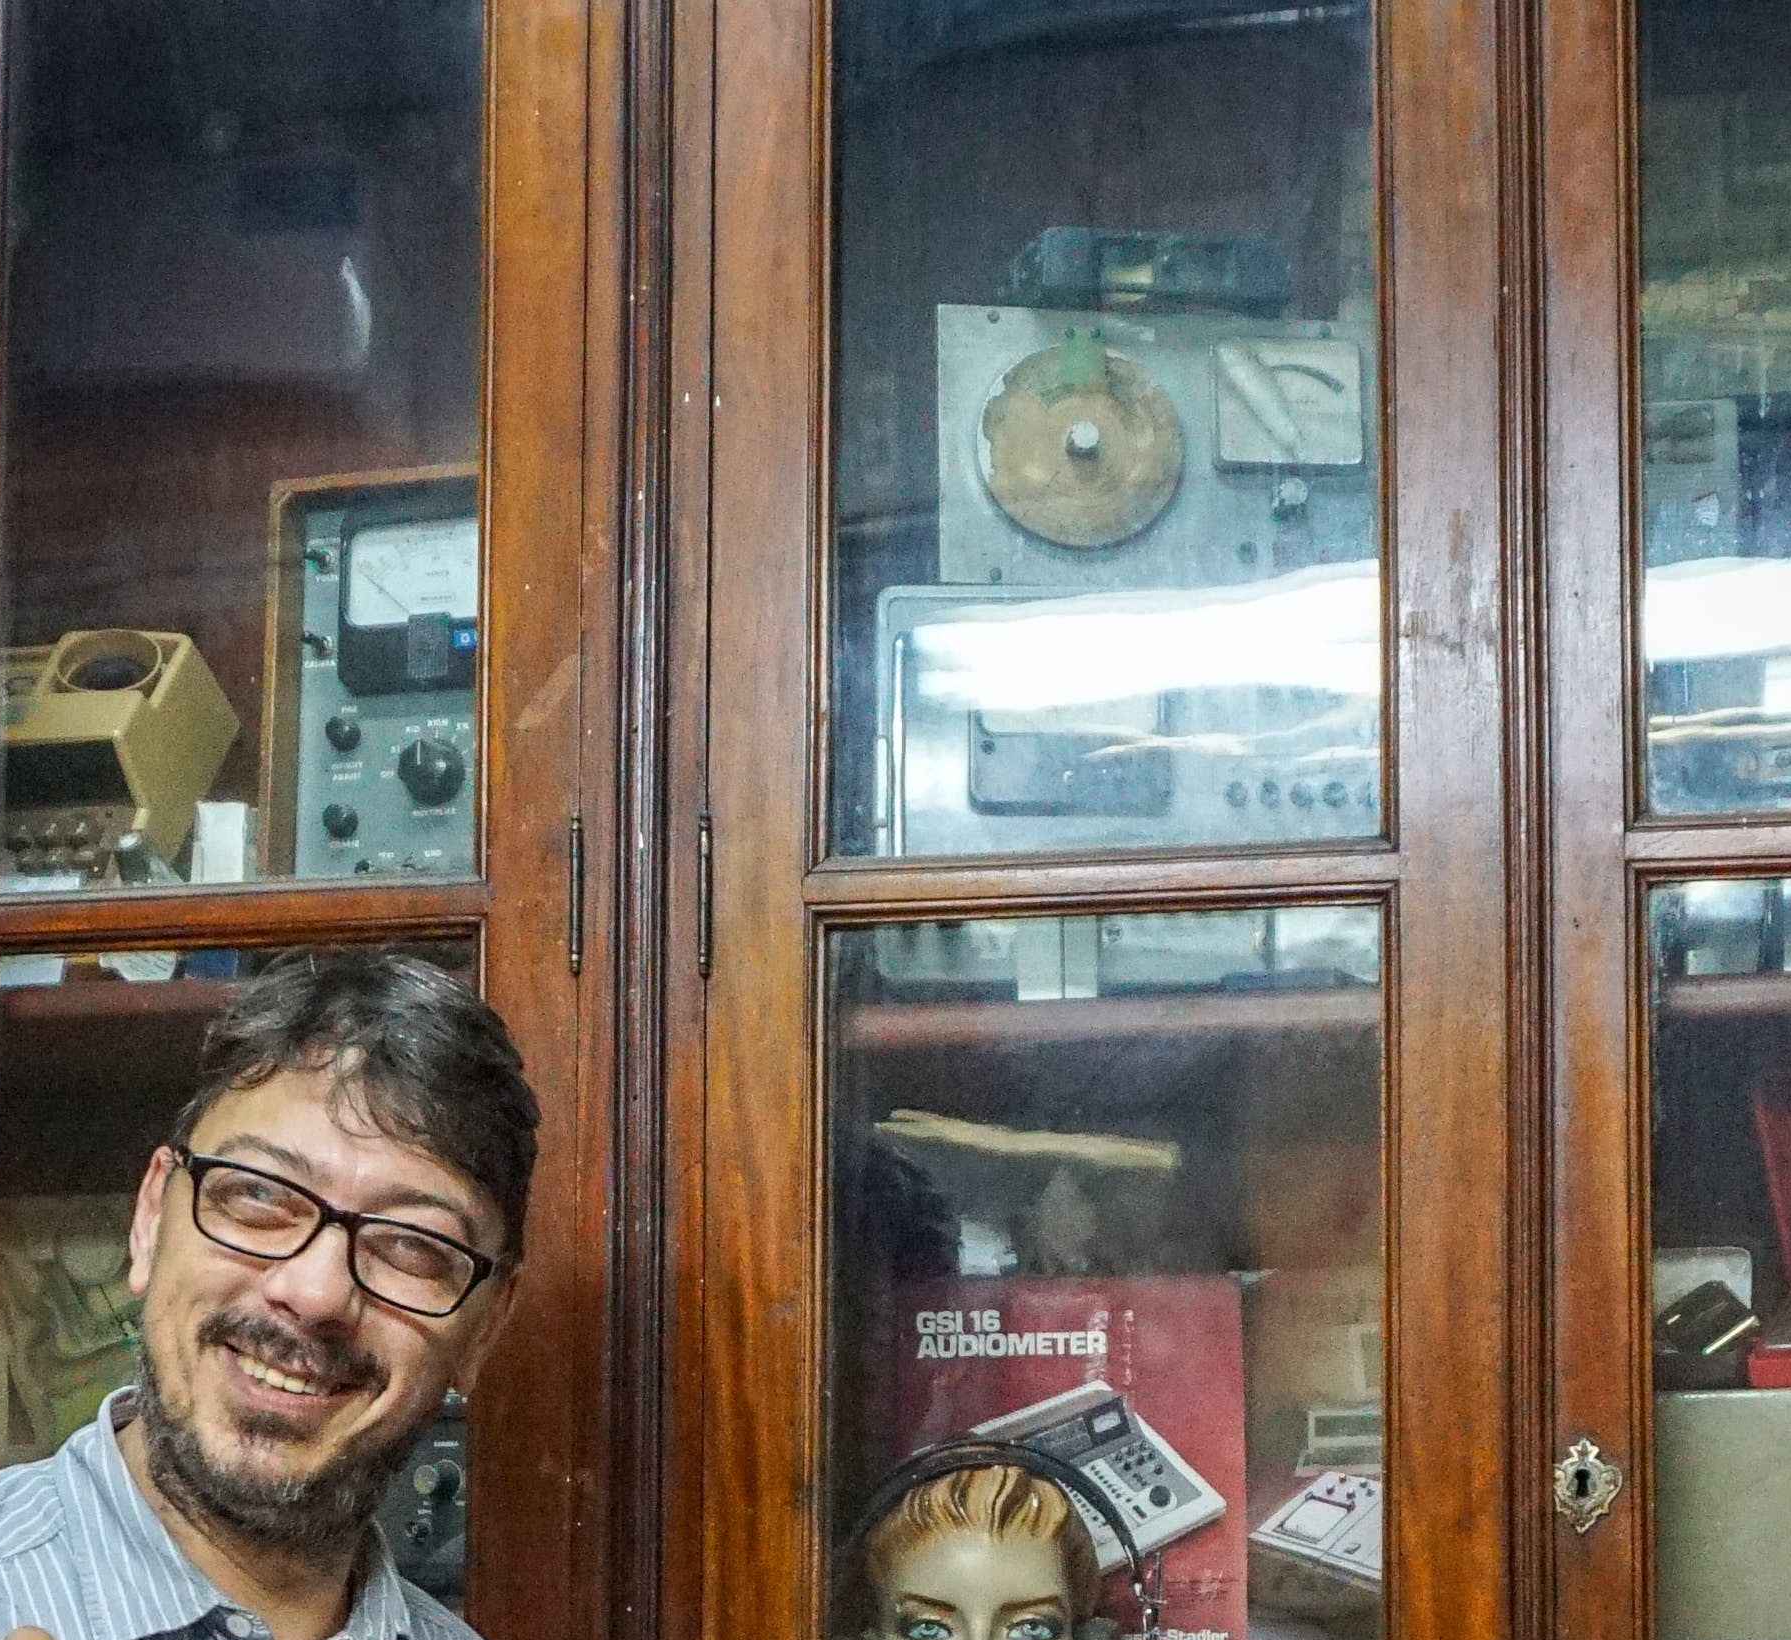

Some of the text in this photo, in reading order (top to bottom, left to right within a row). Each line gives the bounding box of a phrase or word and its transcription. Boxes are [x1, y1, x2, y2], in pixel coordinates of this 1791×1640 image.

[916, 1309, 1001, 1334] GSI 16
[916, 1331, 1107, 1359] AUDIOMETER
